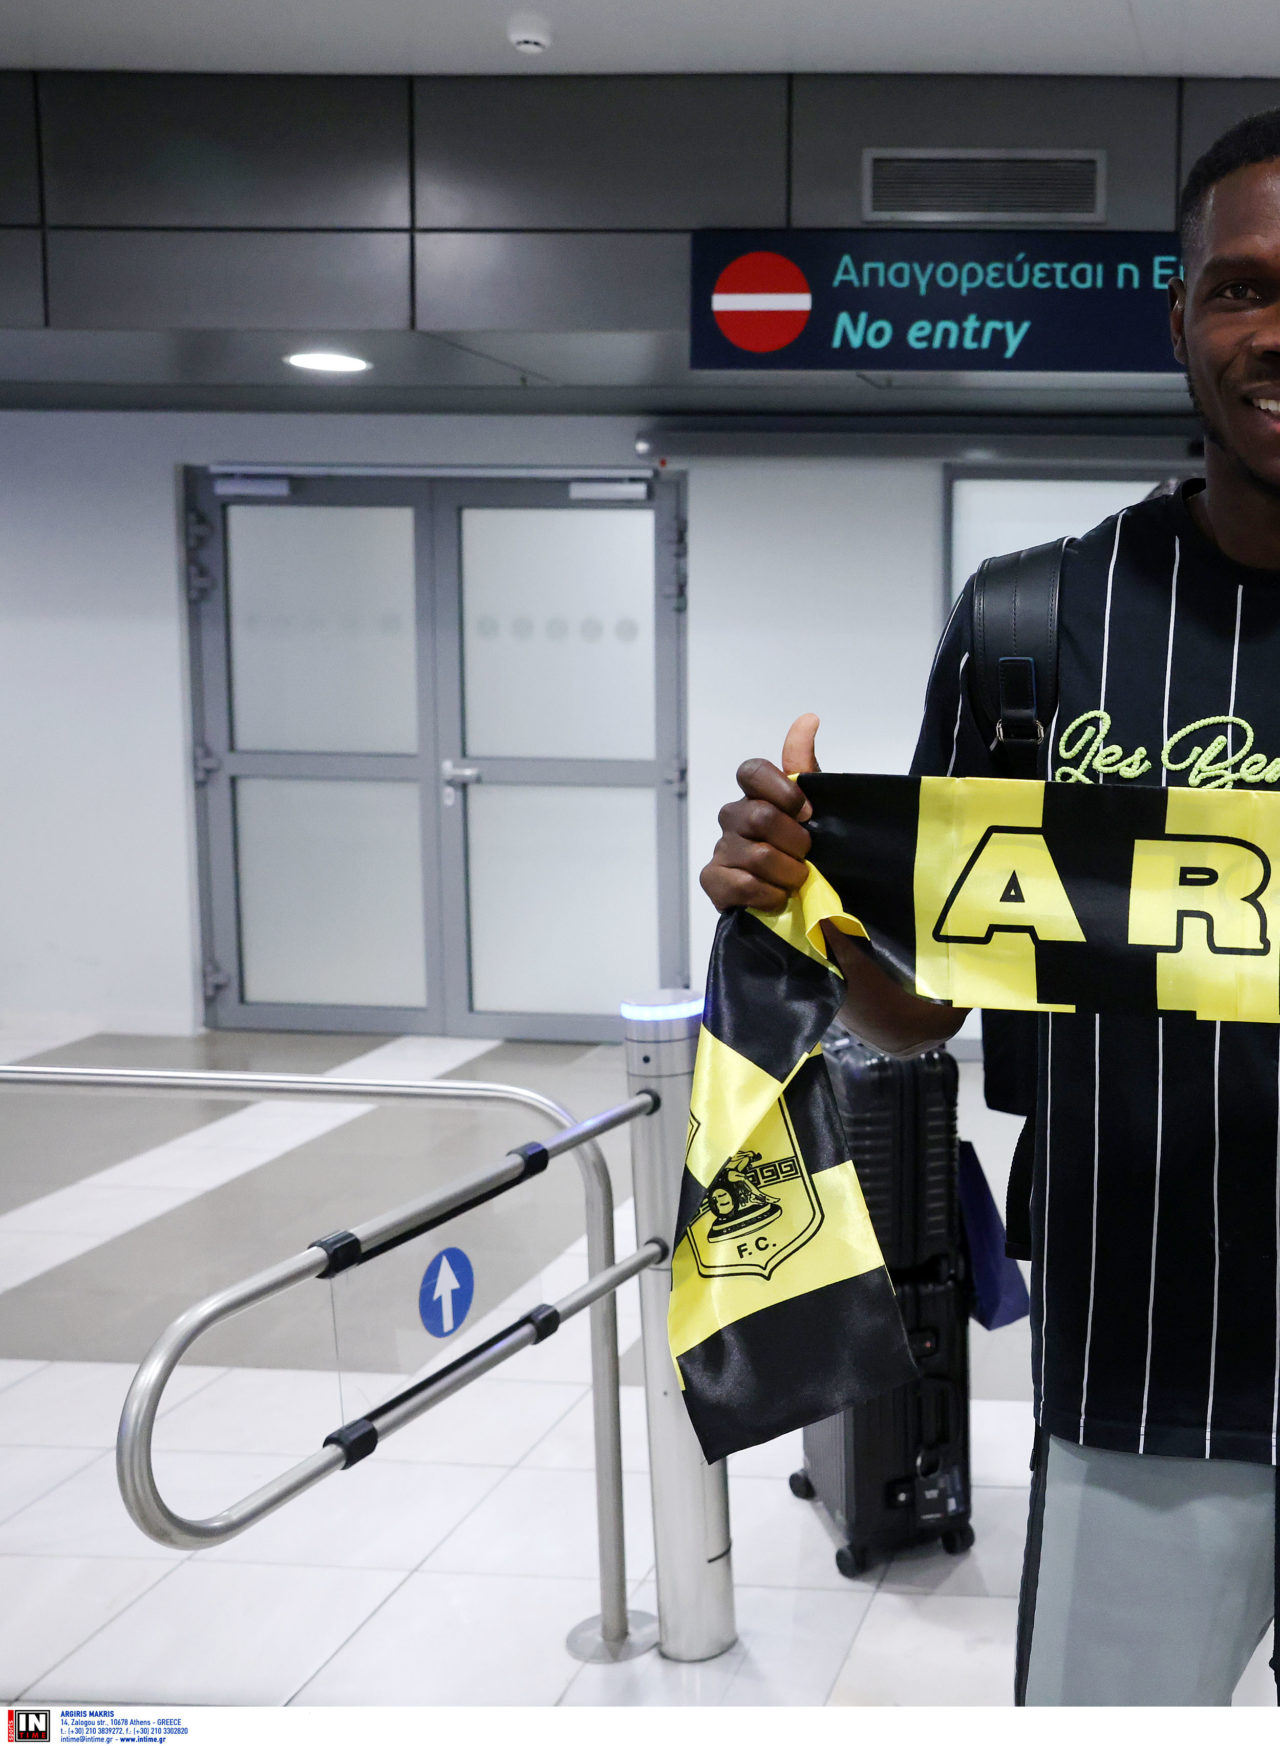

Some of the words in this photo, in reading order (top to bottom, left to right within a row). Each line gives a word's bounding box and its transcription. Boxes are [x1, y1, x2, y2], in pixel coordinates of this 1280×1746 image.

[832, 252, 1103, 296] Απαγορεύεται
[831, 311, 893, 349] No
[906, 313, 1031, 359] entry
[1055, 709, 1152, 785] Les
